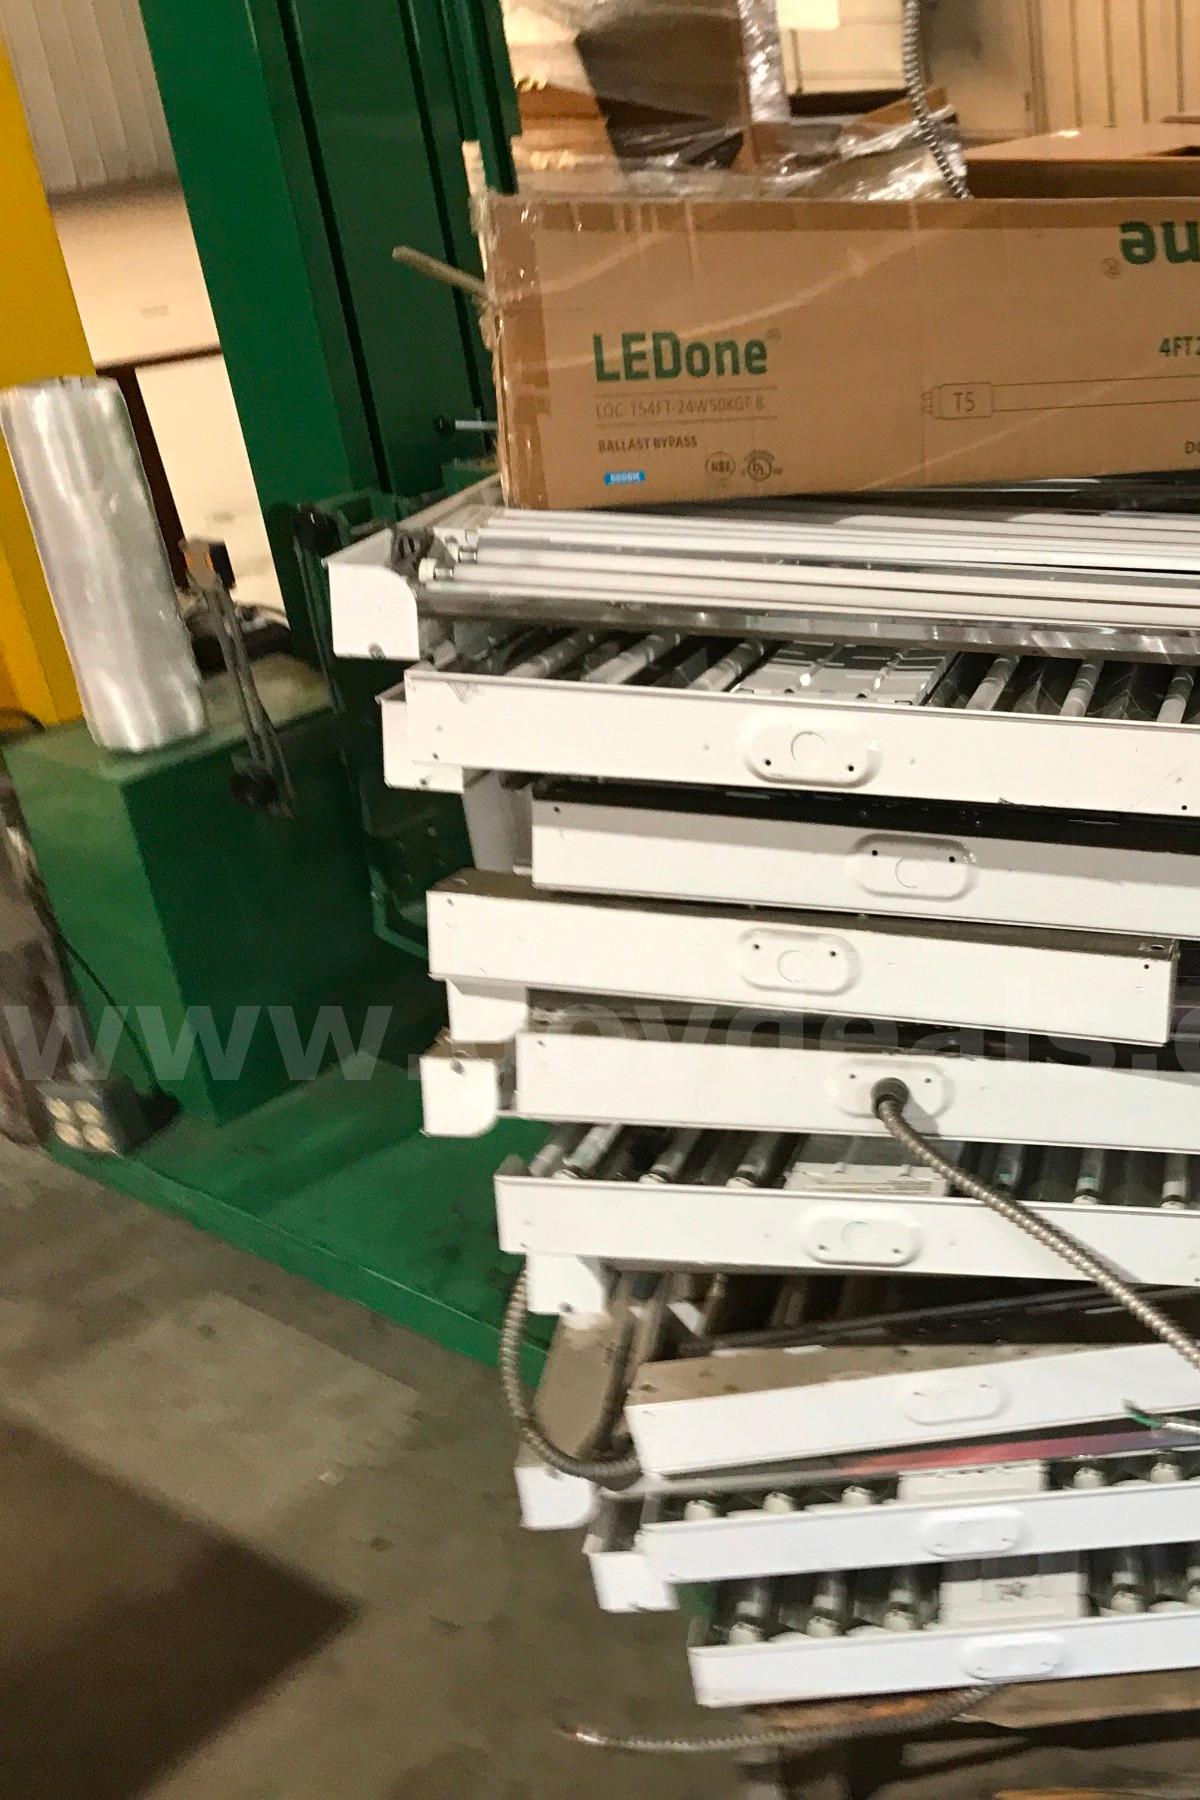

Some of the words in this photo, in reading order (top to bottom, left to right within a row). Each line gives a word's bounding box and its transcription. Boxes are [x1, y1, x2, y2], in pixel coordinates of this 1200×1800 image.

[592, 330, 768, 382] LEDone
[953, 391, 976, 412] T5
[598, 436, 651, 454] BALLAST
[653, 434, 698, 451] BYPASS
